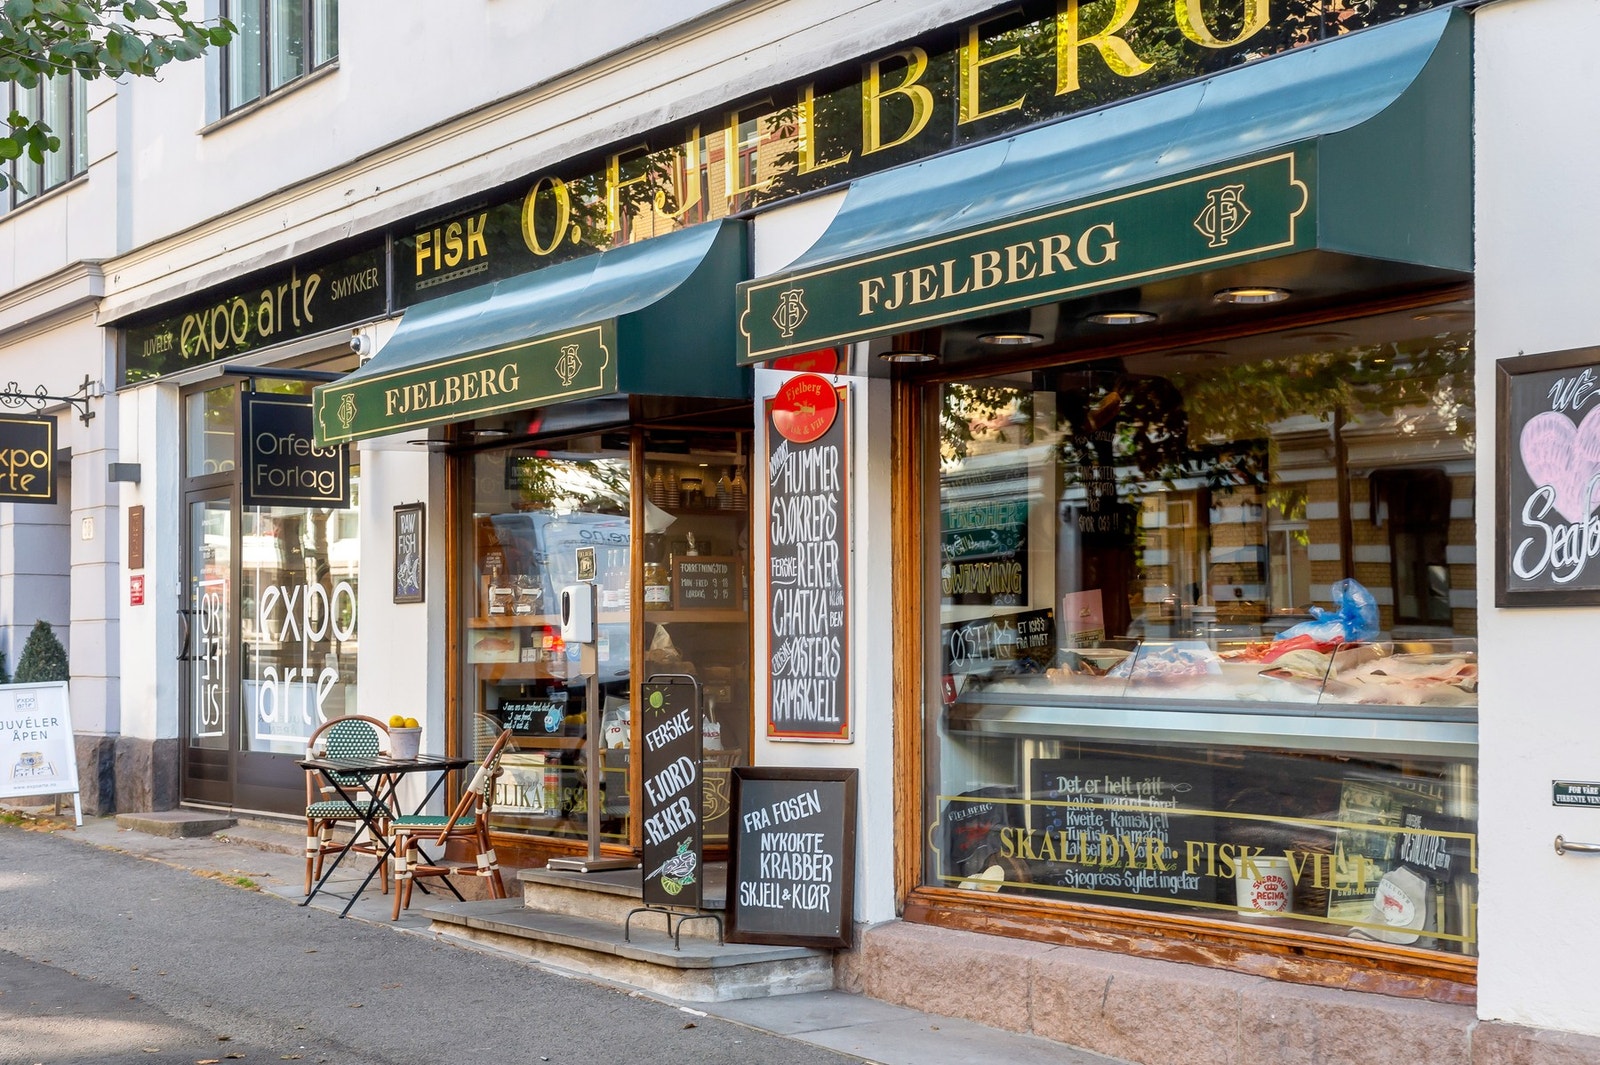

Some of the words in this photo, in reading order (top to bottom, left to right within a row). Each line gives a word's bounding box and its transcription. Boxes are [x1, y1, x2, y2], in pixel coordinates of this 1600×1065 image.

[415, 213, 488, 277] FISK
[331, 267, 379, 301] SMYKKER
[859, 223, 1120, 316] FJELBERG
[180, 298, 249, 360] expo
[257, 265, 321, 337] arte
[385, 362, 520, 416] FJELBERG
[785, 381, 822, 401] Fjelberg
[257, 464, 335, 494] Forlag
[784, 445, 840, 494] HUMMER
[771, 493, 838, 545] SJØKREPS
[398, 533, 416, 554] FISH
[771, 556, 797, 577] FERSKE
[796, 541, 842, 588] REKER
[201, 592, 220, 634] OR
[260, 581, 356, 643] expo
[772, 588, 829, 637] CHATKA
[788, 636, 841, 678] ØSTERS
[202, 684, 219, 725] US
[260, 665, 339, 726] arte
[772, 678, 840, 722] KAMSKJELL
[13, 730, 48, 742] ÅPEN
[645, 708, 695, 753] FERSKE
[1056, 775, 1081, 793] Det
[1085, 779, 1101, 794] er
[1104, 775, 1133, 795] helt
[743, 807, 771, 833] FRA
[772, 789, 822, 825] FOSEN
[1066, 811, 1104, 827] Kveite
[1110, 812, 1169, 832] Kamskjell
[760, 832, 824, 854] NYKOKTE
[1000, 826, 1168, 872] SKALLDYR
[1185, 840, 1269, 880] FISK
[1284, 850, 1374, 893] VILT
[760, 852, 834, 883] KRABBER
[740, 881, 784, 909] SKJELL
[782, 888, 792, 901] &
[792, 883, 830, 913] KLØR
